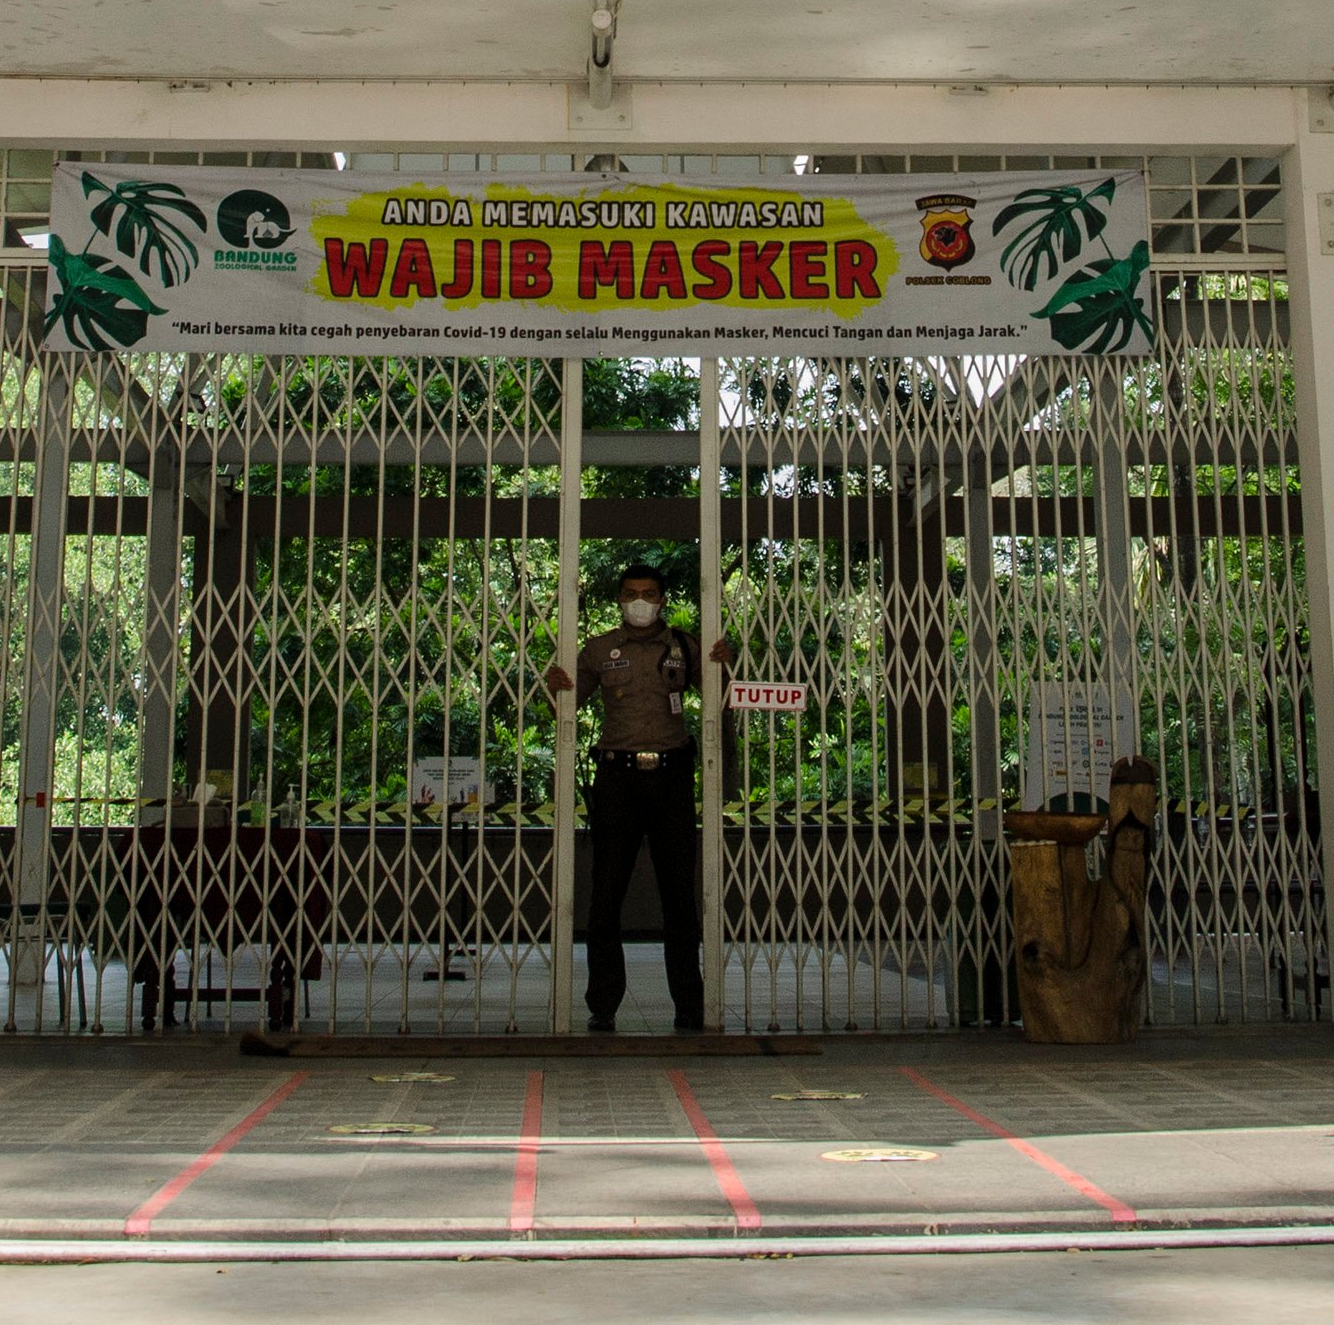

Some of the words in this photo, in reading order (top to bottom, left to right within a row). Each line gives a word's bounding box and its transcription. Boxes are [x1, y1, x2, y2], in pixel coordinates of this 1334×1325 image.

[382, 198, 472, 227] ANDA
[482, 200, 656, 229] MEMASUKI
[666, 200, 824, 229] KAWASAN
[214, 250, 297, 264] BANDUNG
[323, 237, 553, 299] WAJIB
[577, 239, 882, 301] MASKER
[905, 276, 944, 286] POLSEK
[945, 276, 992, 285] COBLONG
[215, 321, 275, 336] bersama
[279, 322, 307, 336] kita
[311, 323, 352, 339] cegah
[356, 324, 440, 340] penyebaran
[443, 325, 506, 339] Covid-19
[510, 326, 562, 341] dengan
[565, 327, 608, 339] selalu
[612, 327, 711, 342] Menggunakan
[714, 326, 769, 340] Masker,
[772, 326, 829, 338] Mencuci
[832, 326, 883, 341] Tangan
[886, 326, 912, 338] dan
[916, 325, 975, 340] Menjaga
[734, 688, 802, 705] TUTUP
